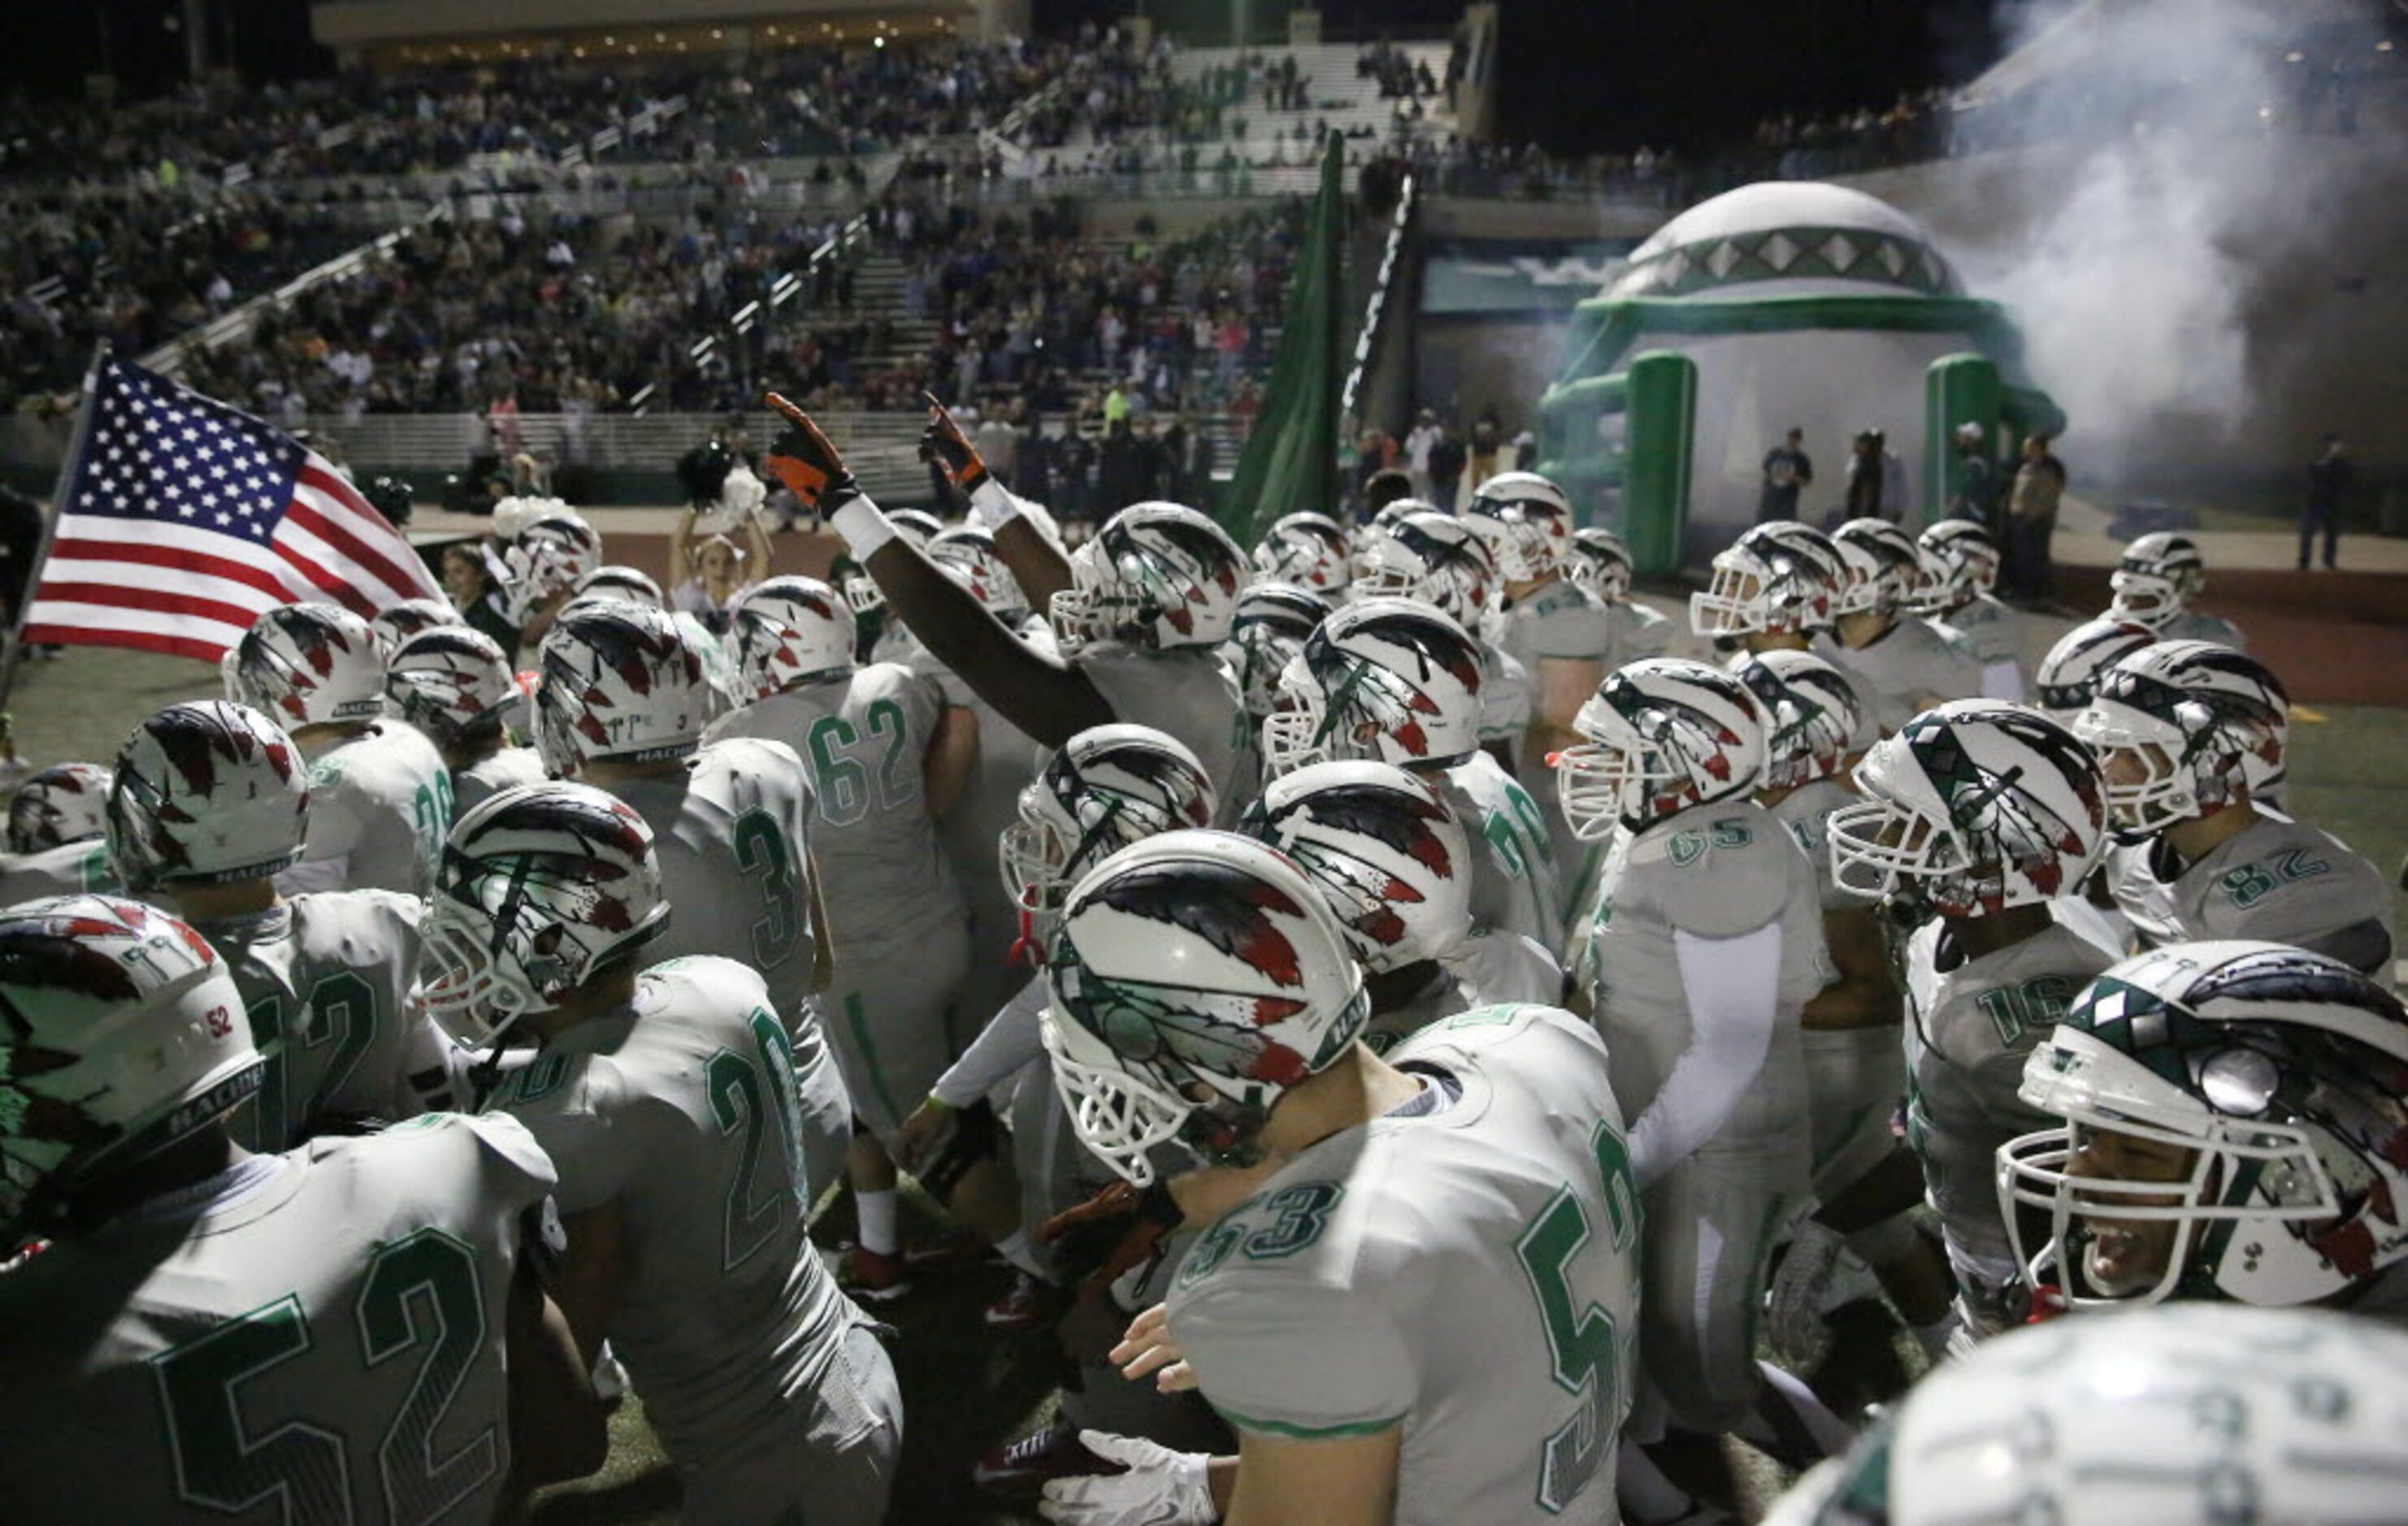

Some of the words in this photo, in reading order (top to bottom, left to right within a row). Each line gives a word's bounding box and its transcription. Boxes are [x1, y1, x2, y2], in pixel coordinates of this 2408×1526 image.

[806, 696, 922, 827] 62
[733, 806, 801, 970] 3
[1666, 815, 1753, 869] 65
[2218, 846, 2331, 911] 82
[206, 1004, 233, 1038] 52
[249, 970, 377, 1152] 12
[1975, 974, 2076, 1049] 16
[1178, 1181, 1347, 1290] 53
[150, 1226, 500, 1526] 52
